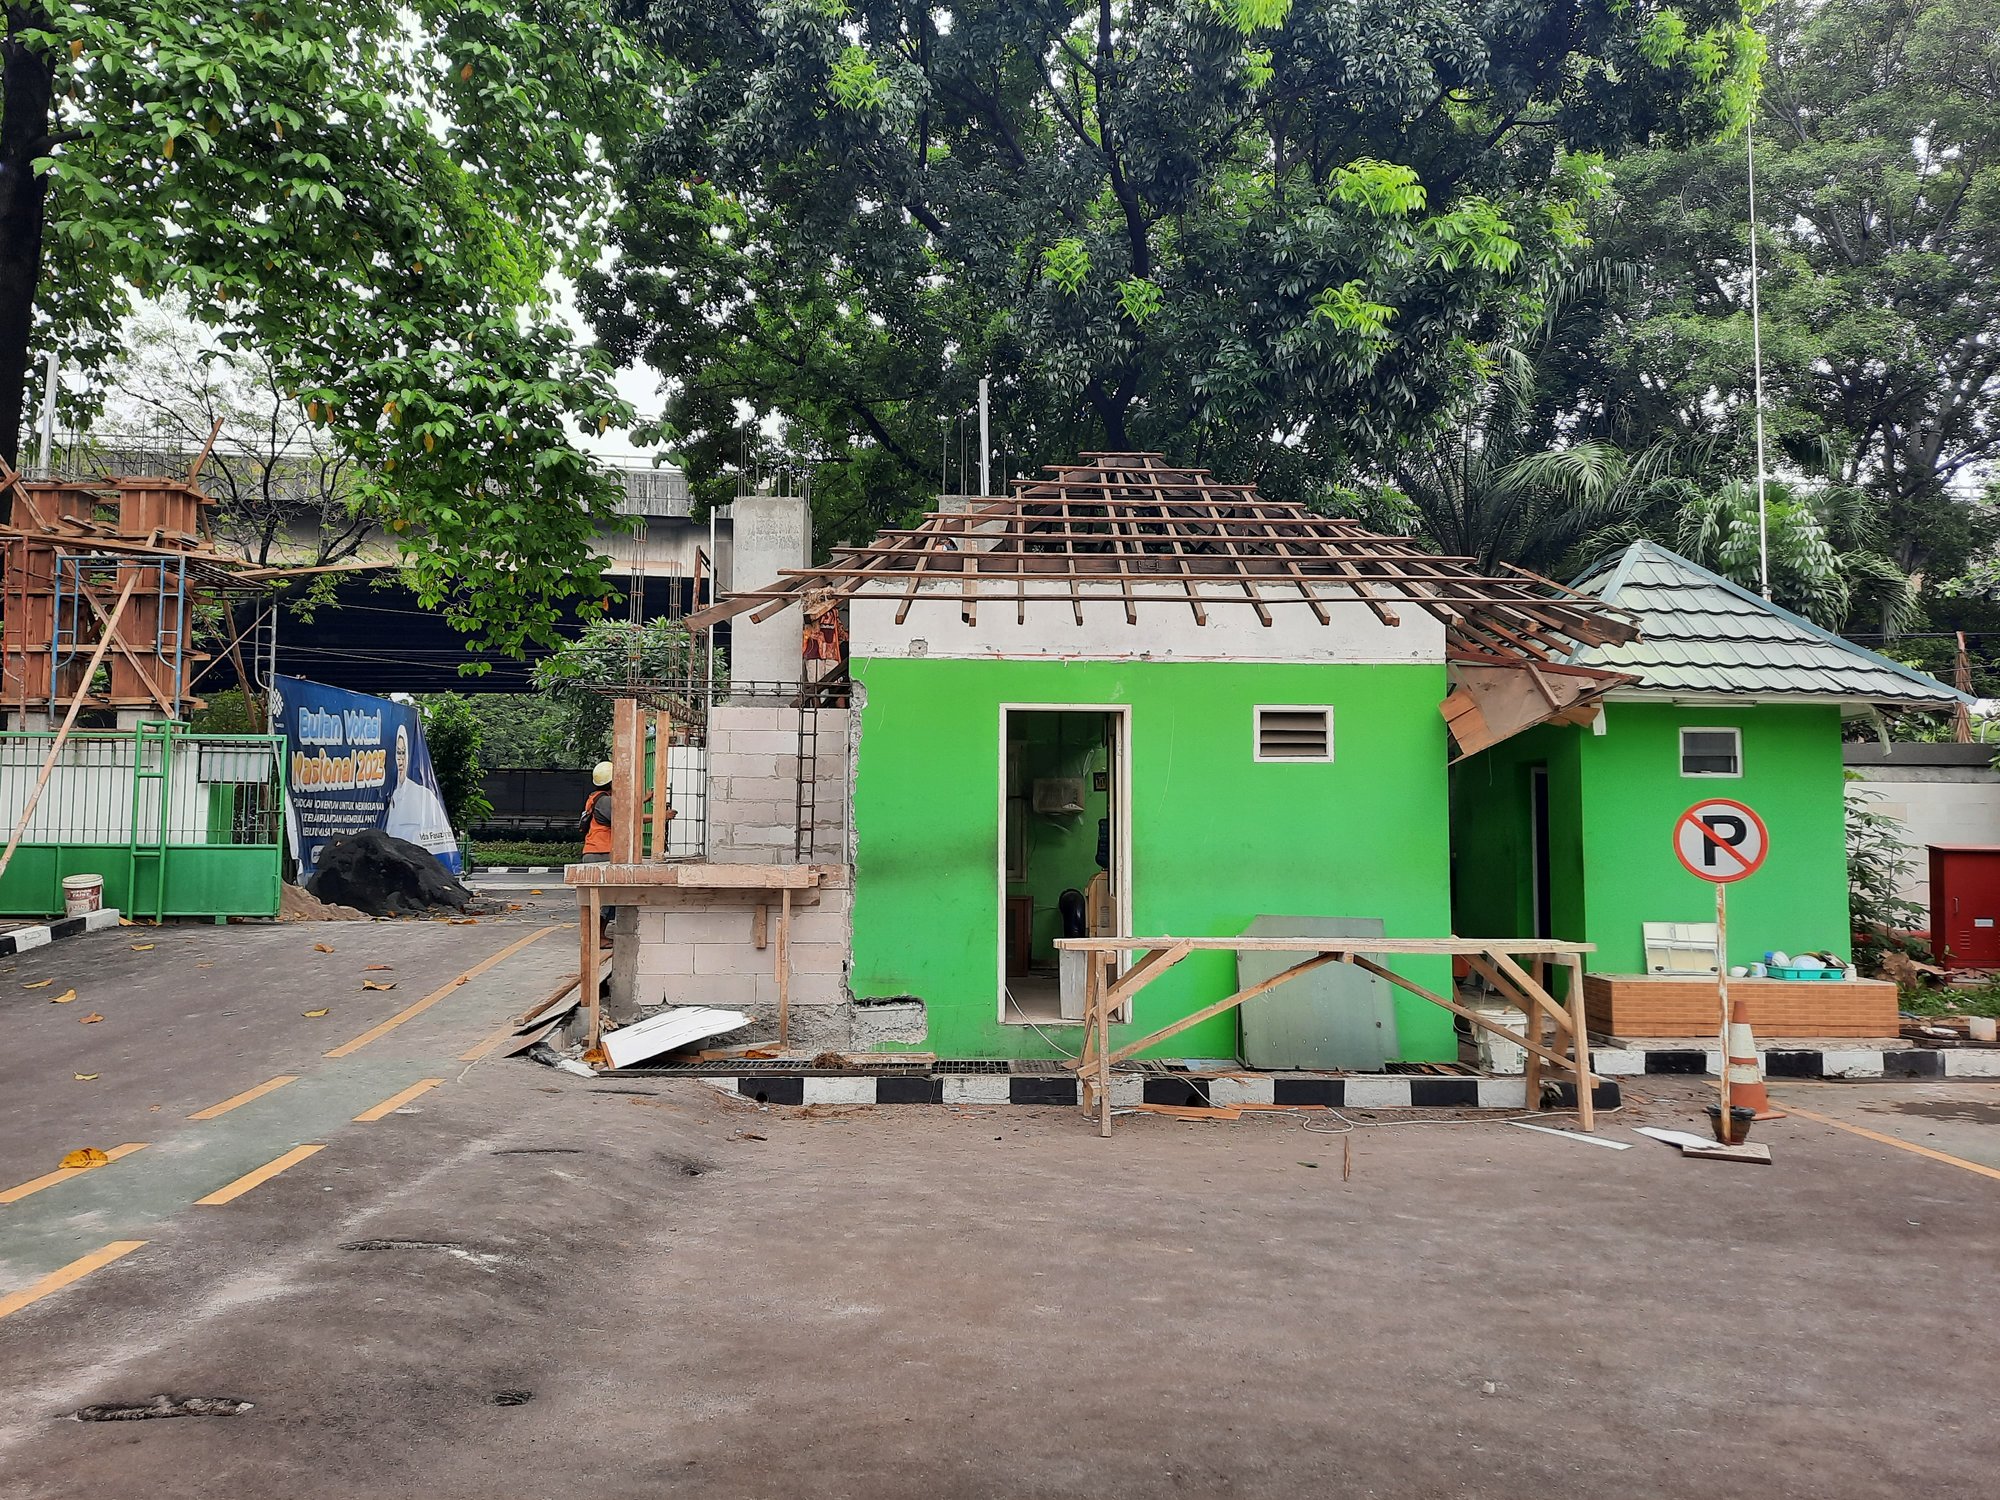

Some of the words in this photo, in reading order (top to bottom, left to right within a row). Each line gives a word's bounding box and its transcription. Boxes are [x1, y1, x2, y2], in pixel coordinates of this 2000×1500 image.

[299, 707, 343, 745] Bulan
[343, 708, 381, 745] Vokasi
[291, 747, 357, 793] Nasional
[356, 749, 386, 788] 2023
[1702, 815, 1747, 866] P
